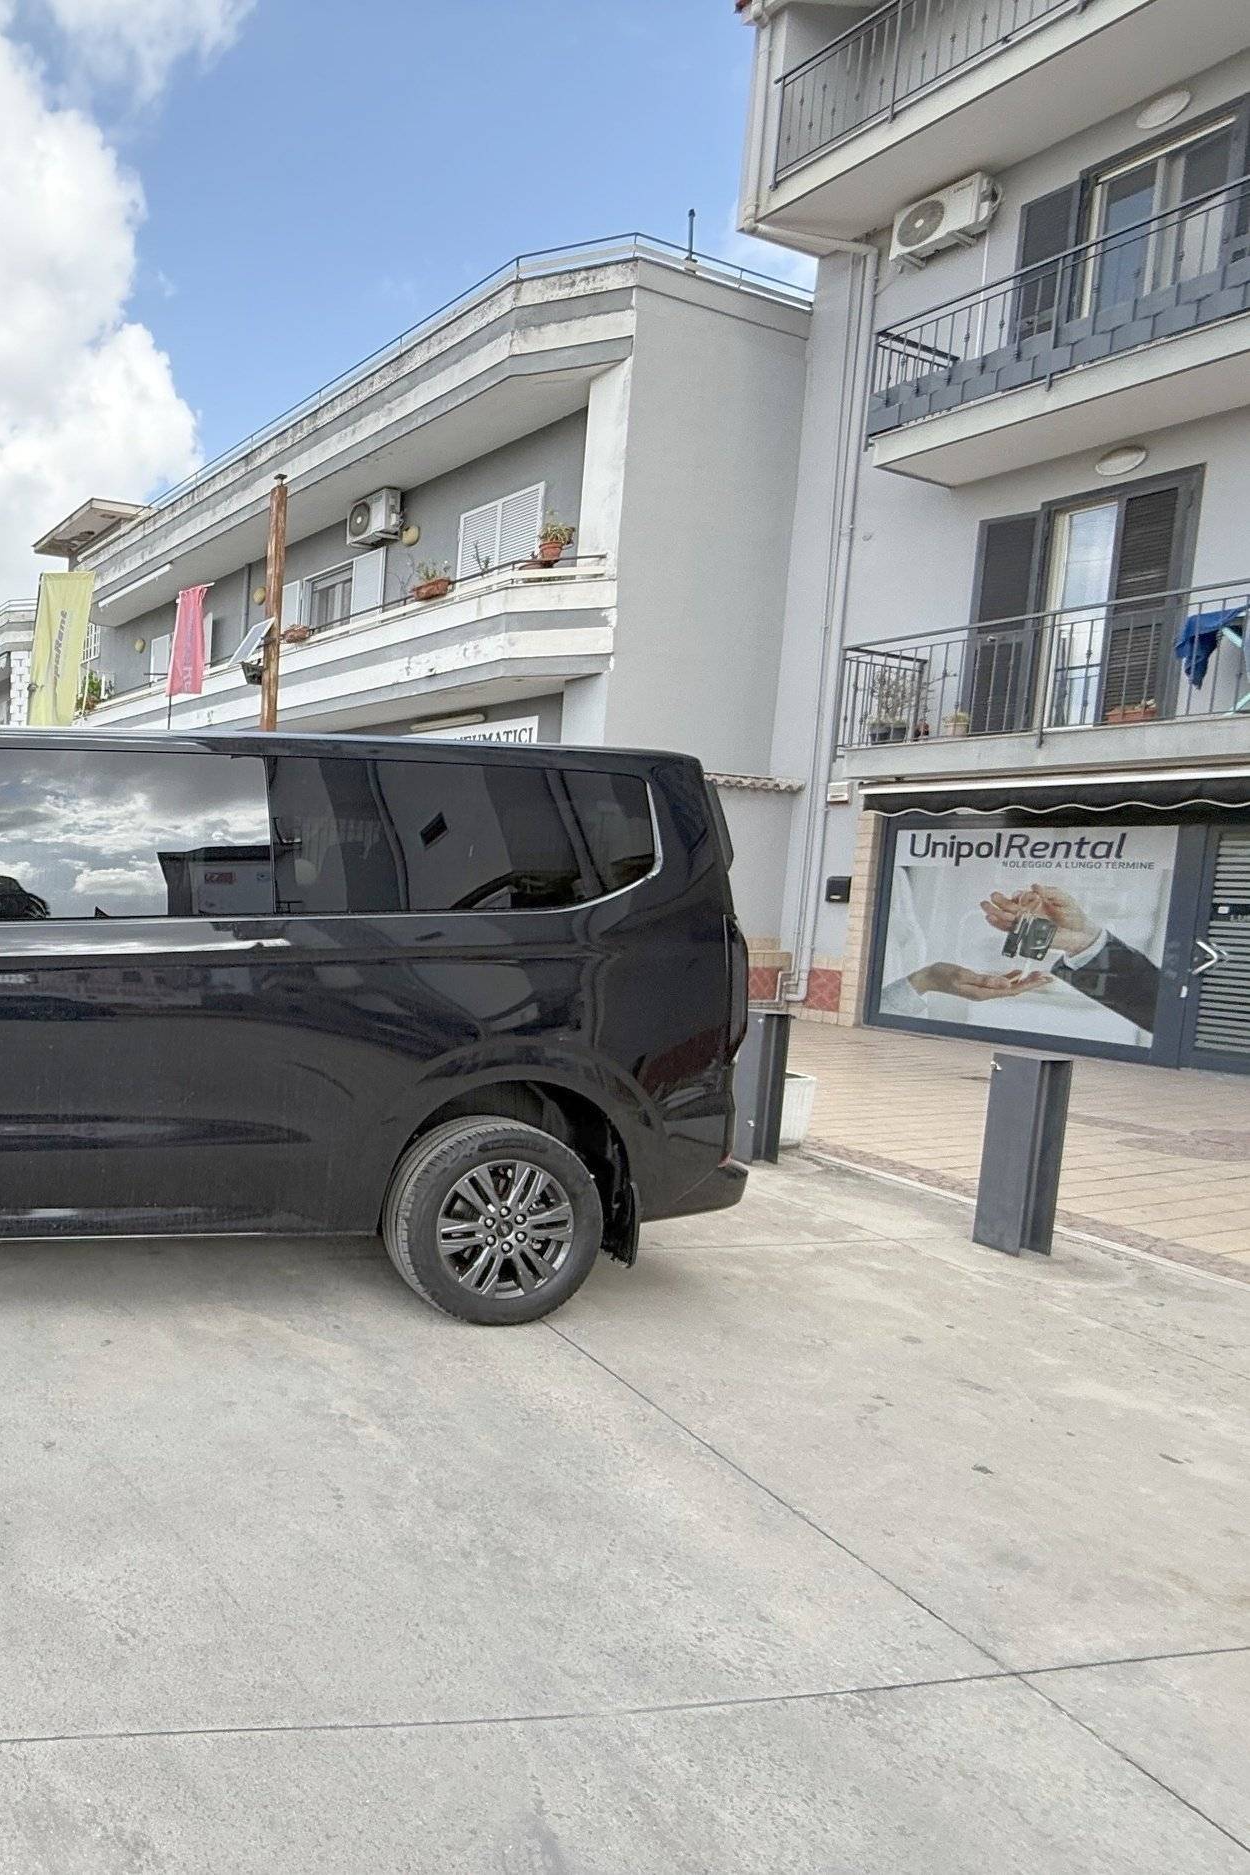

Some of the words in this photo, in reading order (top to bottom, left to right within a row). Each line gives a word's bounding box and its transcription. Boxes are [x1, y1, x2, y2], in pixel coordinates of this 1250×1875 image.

[909, 832, 1127, 866] UnipolRental
[1002, 860, 1051, 869] NOLEGGIO
[1054, 861, 1063, 869] A
[1064, 861, 1102, 869] LUNGO
[1104, 861, 1155, 870] TERMINE
